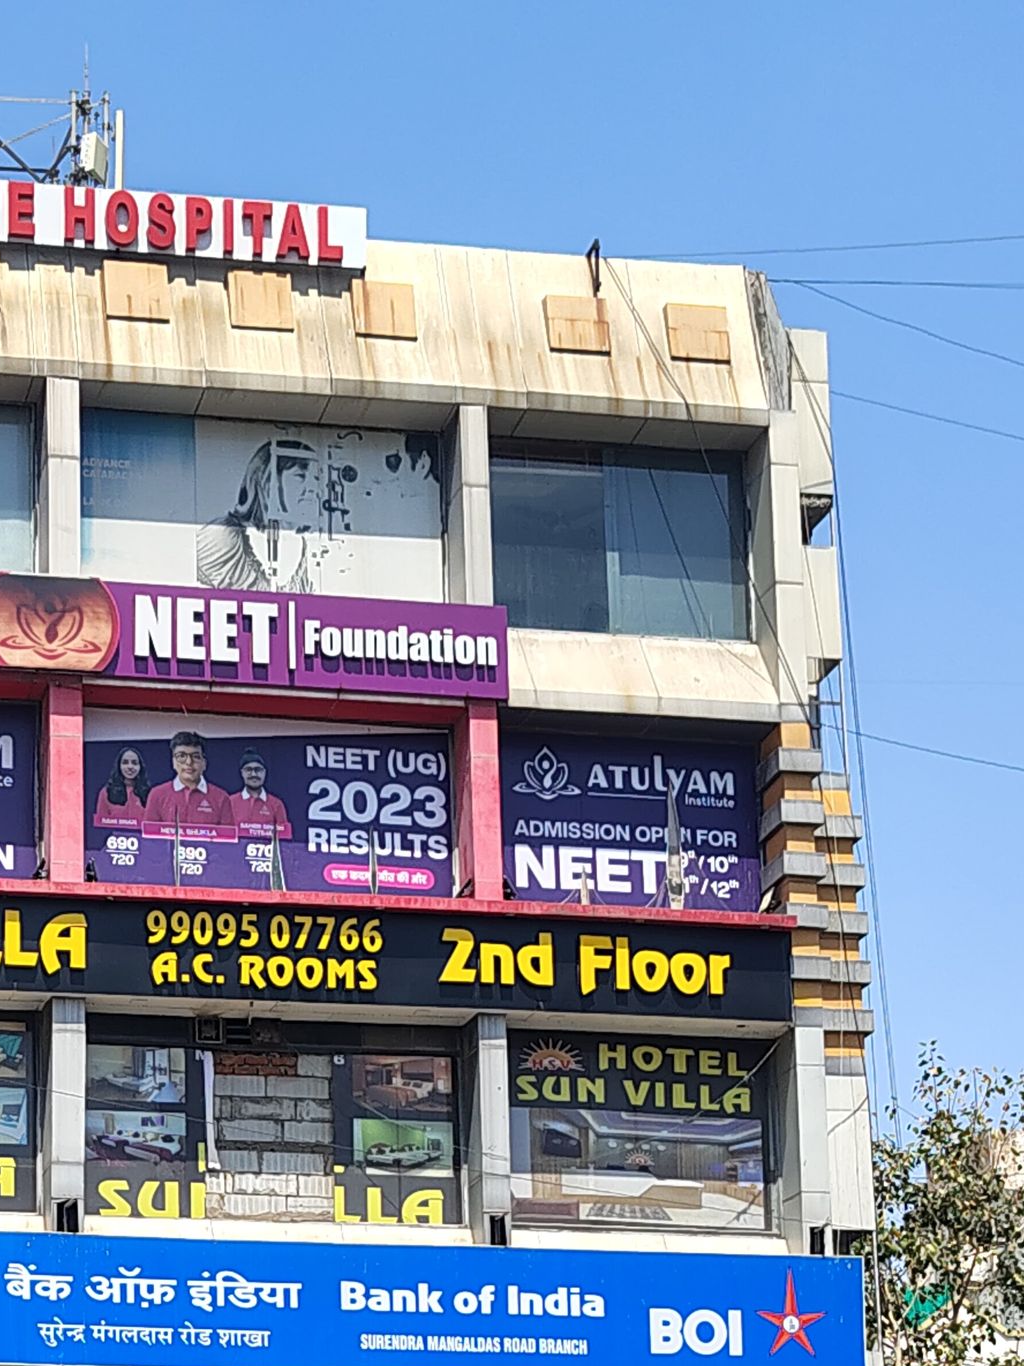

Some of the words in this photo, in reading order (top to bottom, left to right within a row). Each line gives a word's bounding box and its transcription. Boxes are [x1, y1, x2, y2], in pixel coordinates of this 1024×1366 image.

[64, 185, 343, 261] HOSPITAL
[134, 594, 278, 665] NEET
[303, 619, 498, 667] Foundation
[306, 745, 380, 771] NEET
[387, 749, 447, 780] (UG)
[308, 779, 448, 828] 2023
[685, 795, 735, 809] Institute
[106, 836, 139, 851] 690
[308, 827, 448, 860] RESULTS
[514, 819, 630, 842] ADMISSION
[696, 829, 737, 848] FOR
[111, 854, 135, 865] 720
[180, 863, 203, 875] 720
[514, 843, 669, 895] NEET
[146, 909, 258, 947] 99095
[270, 914, 384, 952] 07766
[151, 952, 225, 985] A.C.
[238, 955, 378, 991] ROOMS
[438, 928, 554, 987] 2nd
[579, 935, 731, 996] Floor
[598, 1043, 750, 1077] HOTEL
[516, 1075, 605, 1104] SUN
[623, 1080, 751, 1114] VILLA
[4, 1263, 73, 1300] बैंक
[187, 1271, 302, 1312] इंडिया
[339, 1280, 443, 1314] Bank
[453, 1284, 496, 1316] of
[507, 1284, 606, 1318] India
[38, 1317, 85, 1347] सुरेन्द्र
[90, 1320, 174, 1345] मंगलदास
[178, 1321, 212, 1346] रोड
[217, 1329, 271, 1347] शाखा
[360, 1333, 425, 1352] SURENDRA
[427, 1335, 501, 1353] MANGALDAS
[503, 1336, 536, 1354] ROAD
[539, 1338, 588, 1356] BRANCH
[649, 1307, 744, 1356] BOI
